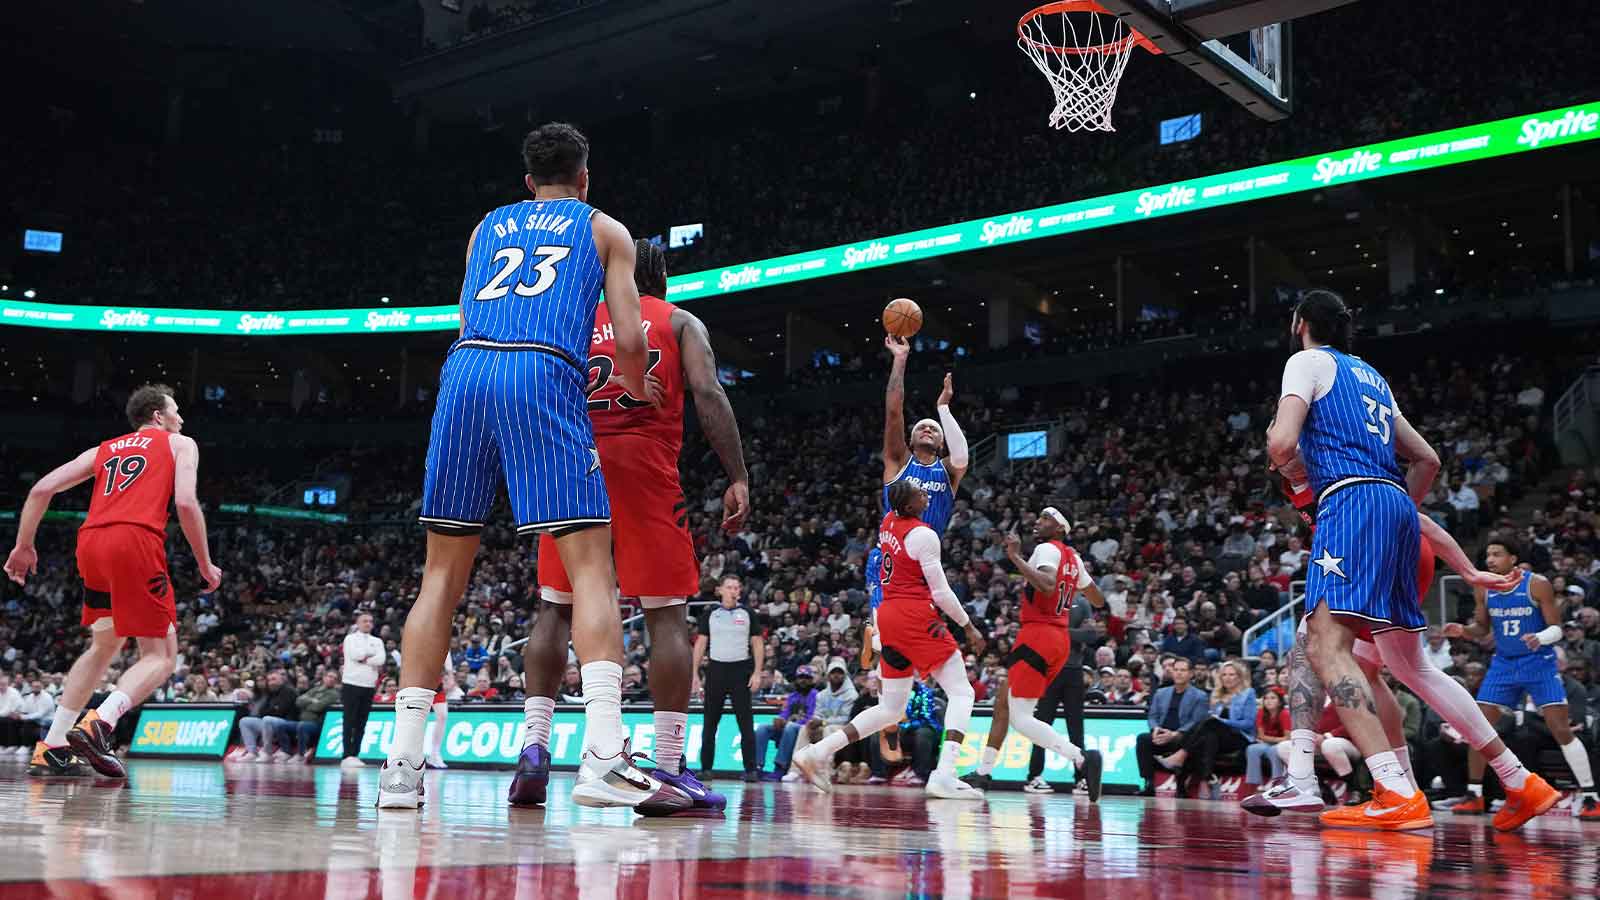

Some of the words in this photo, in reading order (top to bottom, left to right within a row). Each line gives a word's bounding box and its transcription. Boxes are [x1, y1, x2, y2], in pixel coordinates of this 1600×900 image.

[1516, 110, 1599, 146] Sprite
[1312, 150, 1383, 183] Sprite
[1135, 185, 1197, 216] Sprite
[494, 219, 518, 239] DA
[525, 214, 574, 236] SILVA
[980, 216, 1033, 243] Sprite
[842, 242, 890, 270] Sprite
[474, 245, 571, 301] 23
[718, 266, 761, 292] Sprite
[100, 309, 150, 329] Sprite
[237, 313, 285, 333] Sprite
[364, 311, 411, 331] Sprite
[1361, 394, 1392, 446] 35
[109, 436, 152, 453] POELTL
[103, 454, 146, 496] 19
[880, 551, 894, 585] 9
[1502, 620, 1521, 636] 13
[137, 720, 228, 747] SUBWAY
[360, 720, 438, 757] FUL
[446, 721, 576, 759] COUT
[954, 731, 1135, 772] SBY
